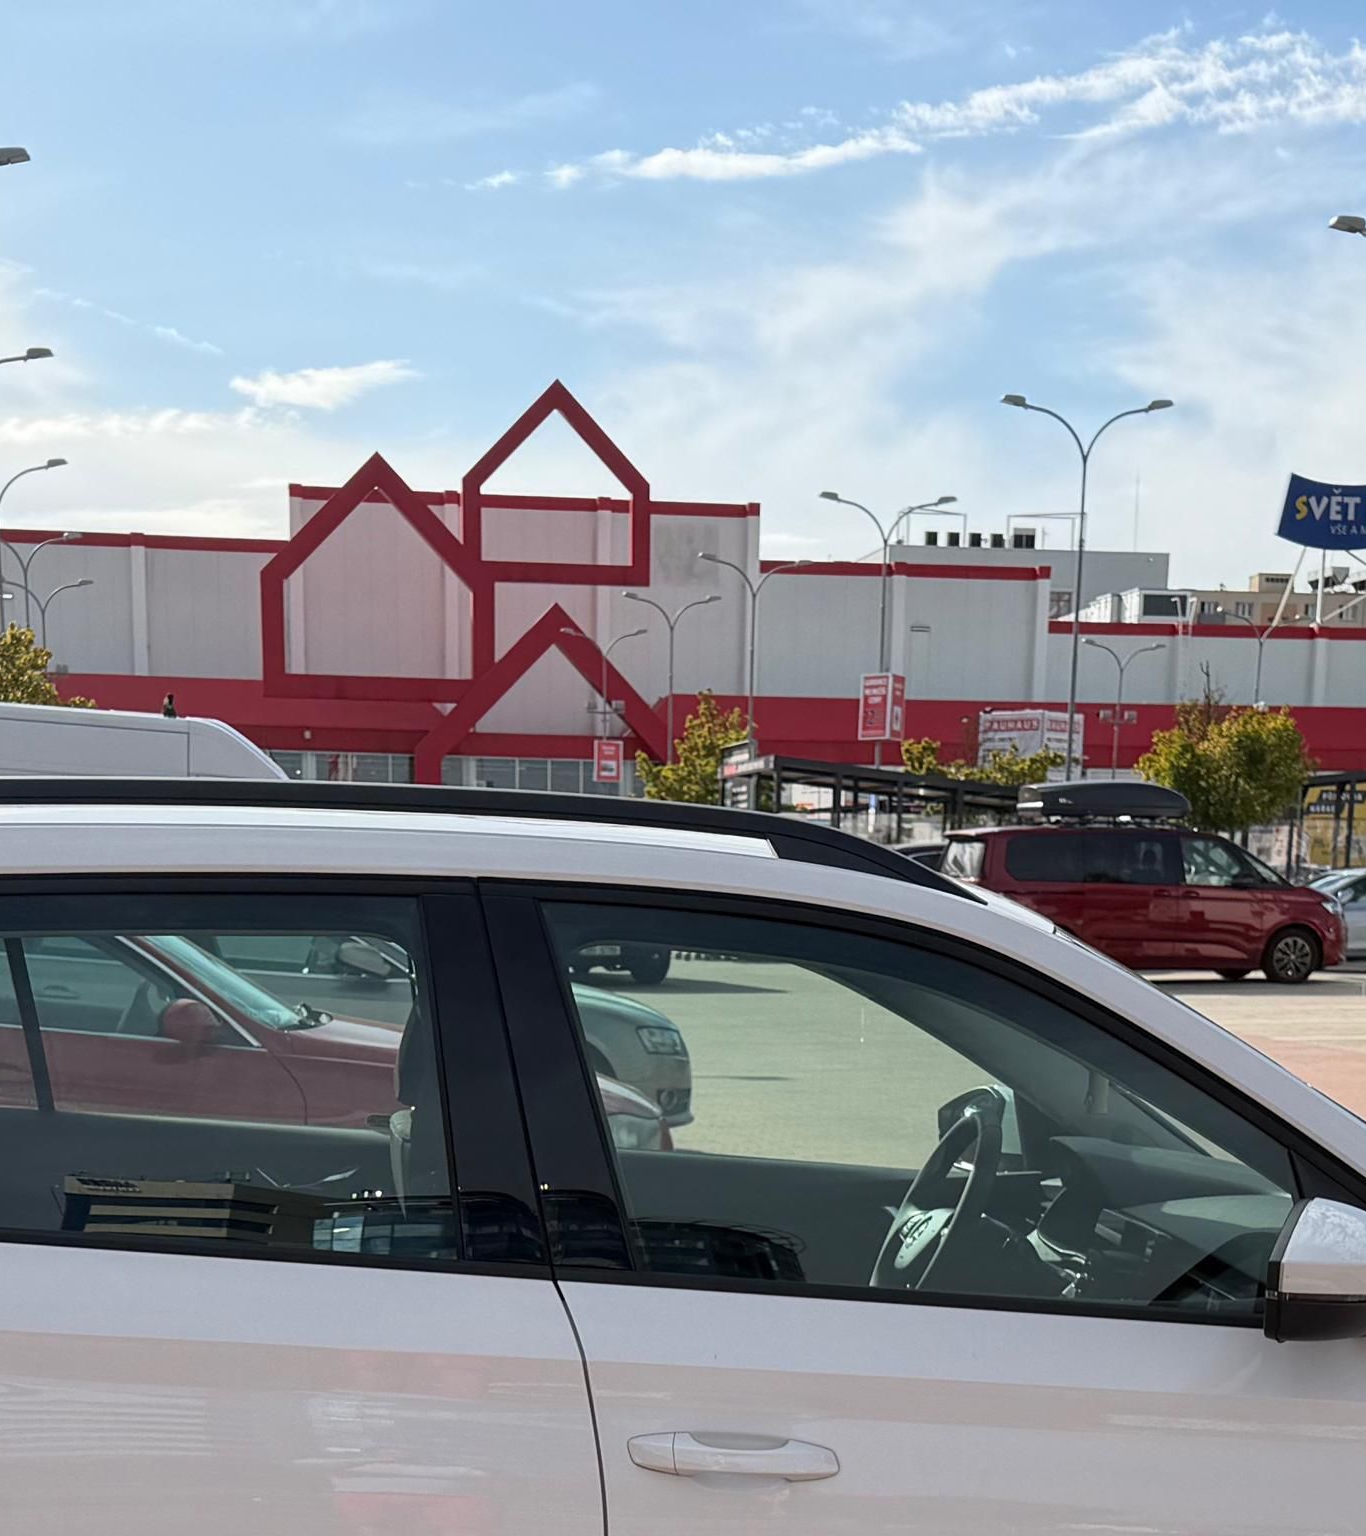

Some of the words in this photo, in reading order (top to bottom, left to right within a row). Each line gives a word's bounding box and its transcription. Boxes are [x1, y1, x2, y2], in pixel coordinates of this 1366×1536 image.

[1295, 488, 1361, 521] SVĚT
[1330, 521, 1347, 535] VŠE
[1349, 523, 1359, 536] A
